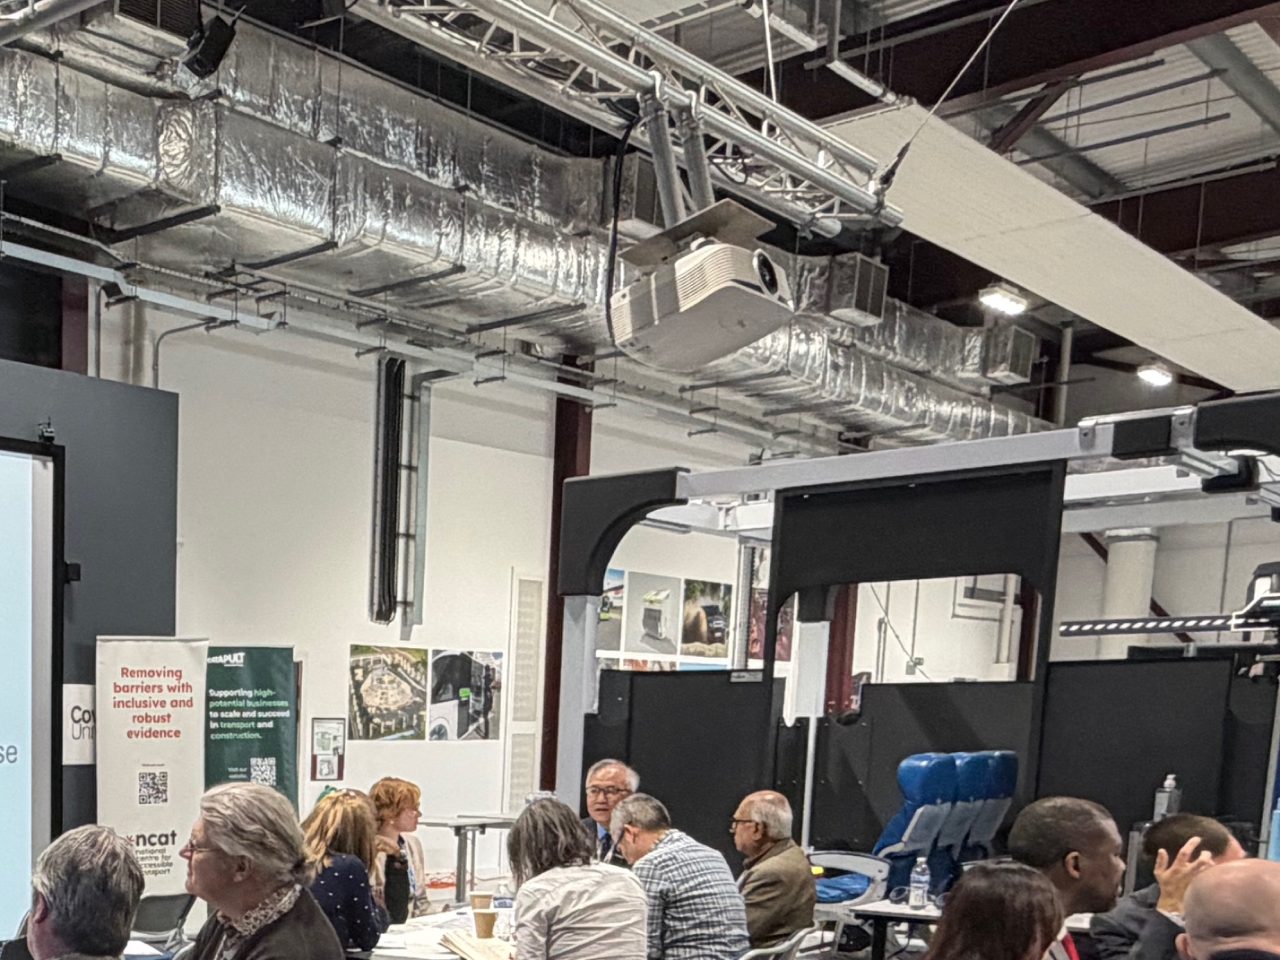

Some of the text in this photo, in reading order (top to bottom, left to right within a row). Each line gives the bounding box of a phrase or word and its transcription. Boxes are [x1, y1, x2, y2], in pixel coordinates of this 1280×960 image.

[121, 666, 183, 680] Removing
[113, 681, 193, 693] barriers with
[208, 688, 253, 698] Supporting
[113, 696, 194, 708] inclusive and
[132, 712, 172, 723] robust
[220, 720, 255, 730] transport
[257, 720, 273, 728] and
[127, 727, 181, 739] evidence
[135, 830, 177, 847] ncat
